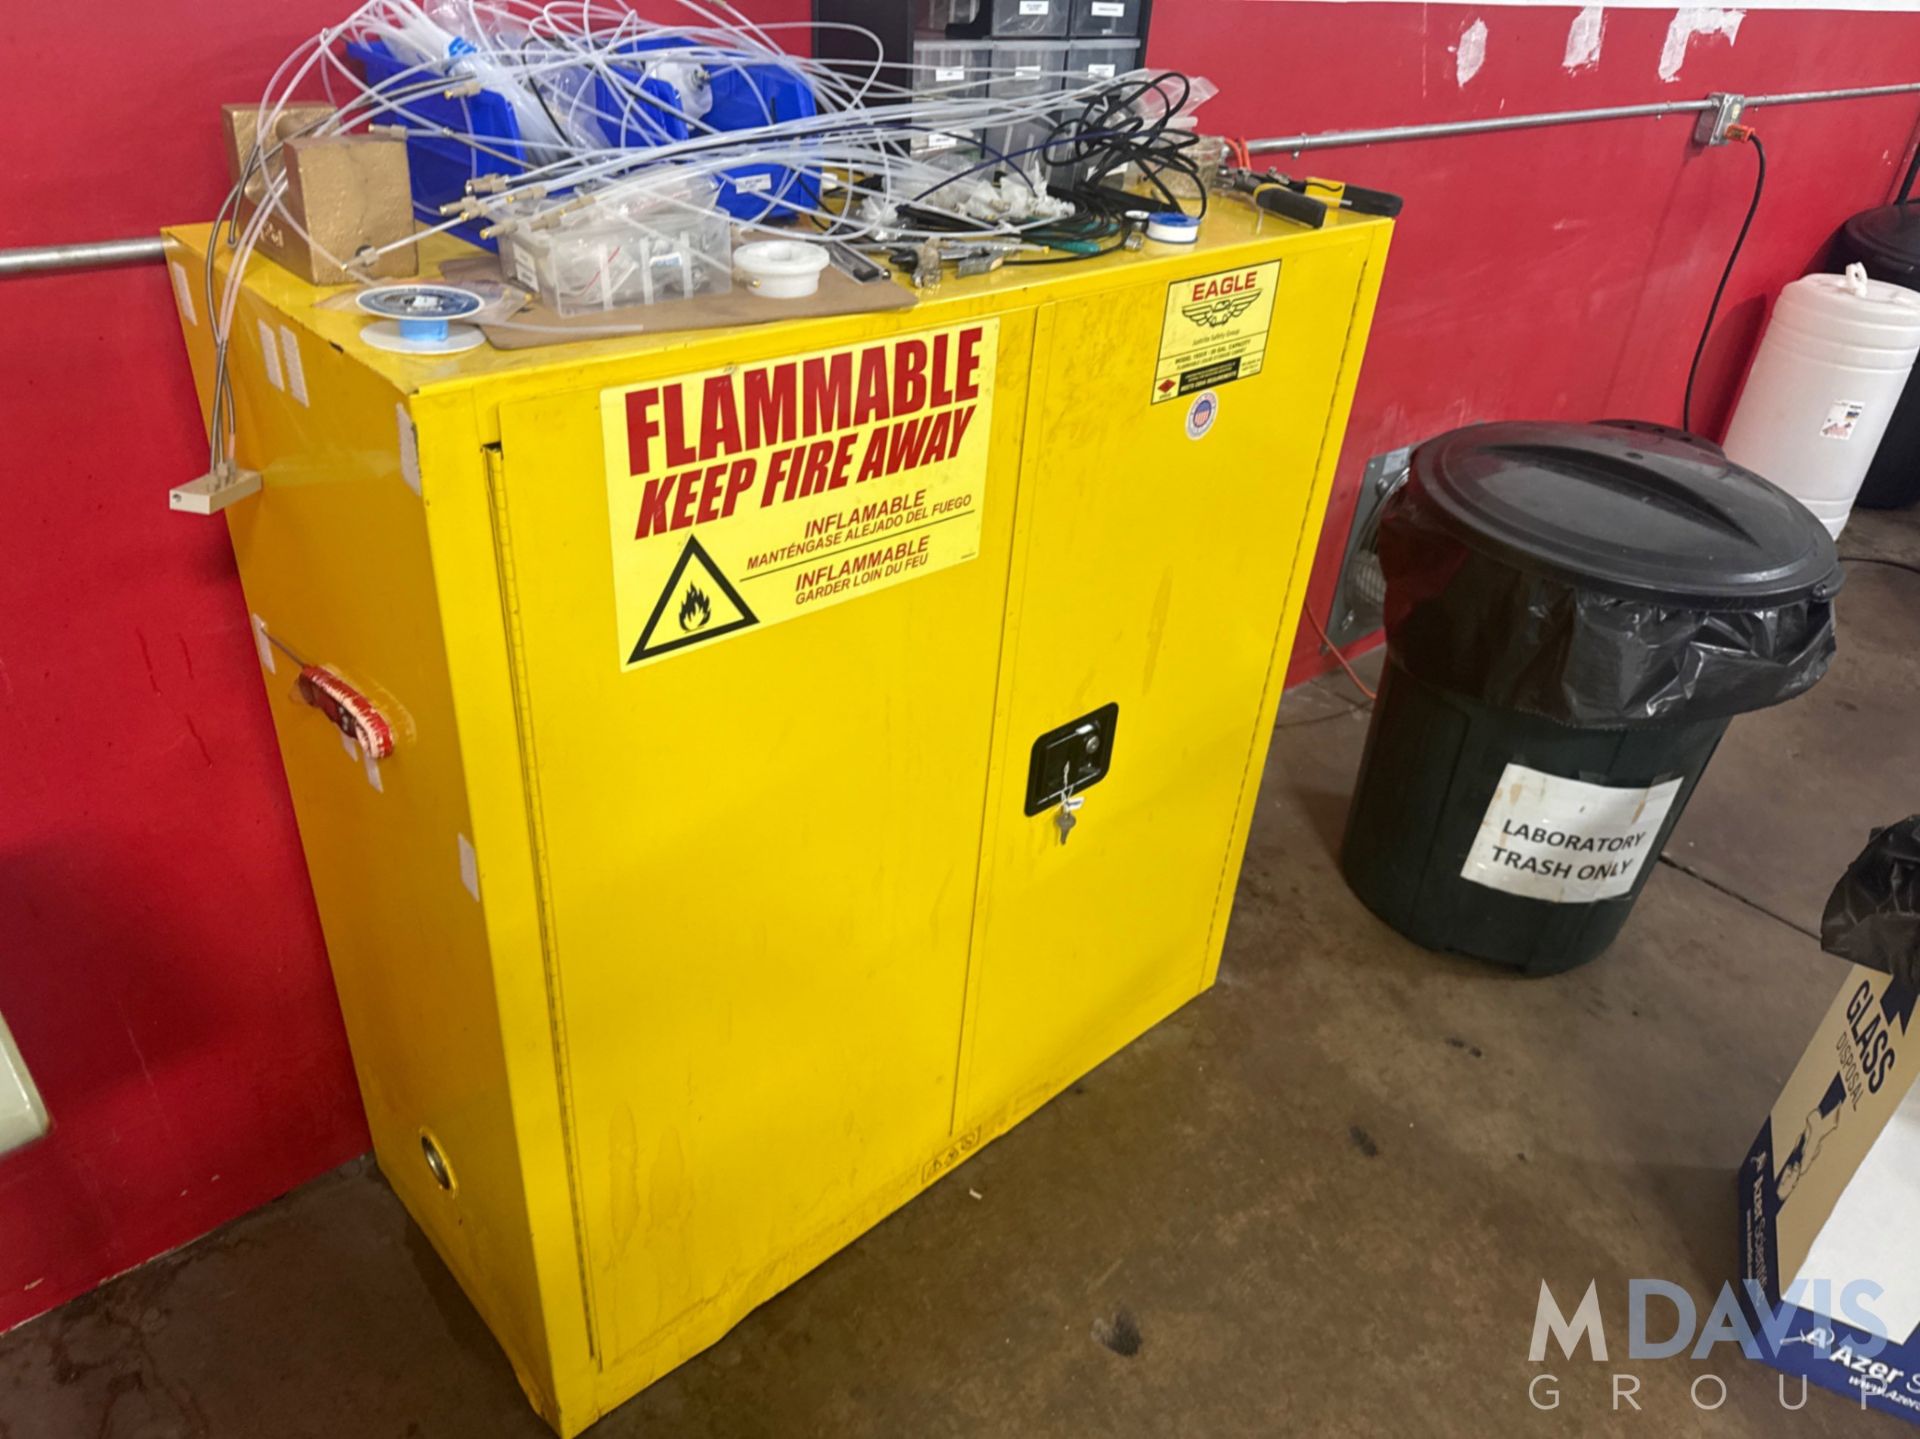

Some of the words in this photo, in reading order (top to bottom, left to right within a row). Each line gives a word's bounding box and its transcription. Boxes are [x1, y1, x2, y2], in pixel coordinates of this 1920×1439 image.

[1192, 271, 1257, 302] EAGLE
[625, 327, 983, 476] FLAMMABLE
[634, 458, 757, 540] KEEP
[760, 433, 858, 509] FIRE
[856, 404, 976, 483] AWAY
[747, 535, 842, 571] MANTÉNGASE
[844, 514, 903, 543] ALEJADO
[905, 506, 928, 524] DEL
[931, 494, 972, 517] FUEGO
[804, 489, 927, 538] INFLAMABLE
[795, 535, 930, 592] INFLAMMABLE
[795, 577, 850, 606] GARDER
[853, 570, 882, 588] LOIN
[884, 562, 902, 579] DU
[904, 552, 928, 572] FEU
[1502, 818, 1647, 853] LABORATORY
[1491, 846, 1573, 880] TRASH
[1577, 858, 1633, 881] ONLY
[1846, 979, 1896, 1094] GLASS
[1836, 1031, 1864, 1112] DISPOSAL
[1829, 1344, 1904, 1384] Azer
